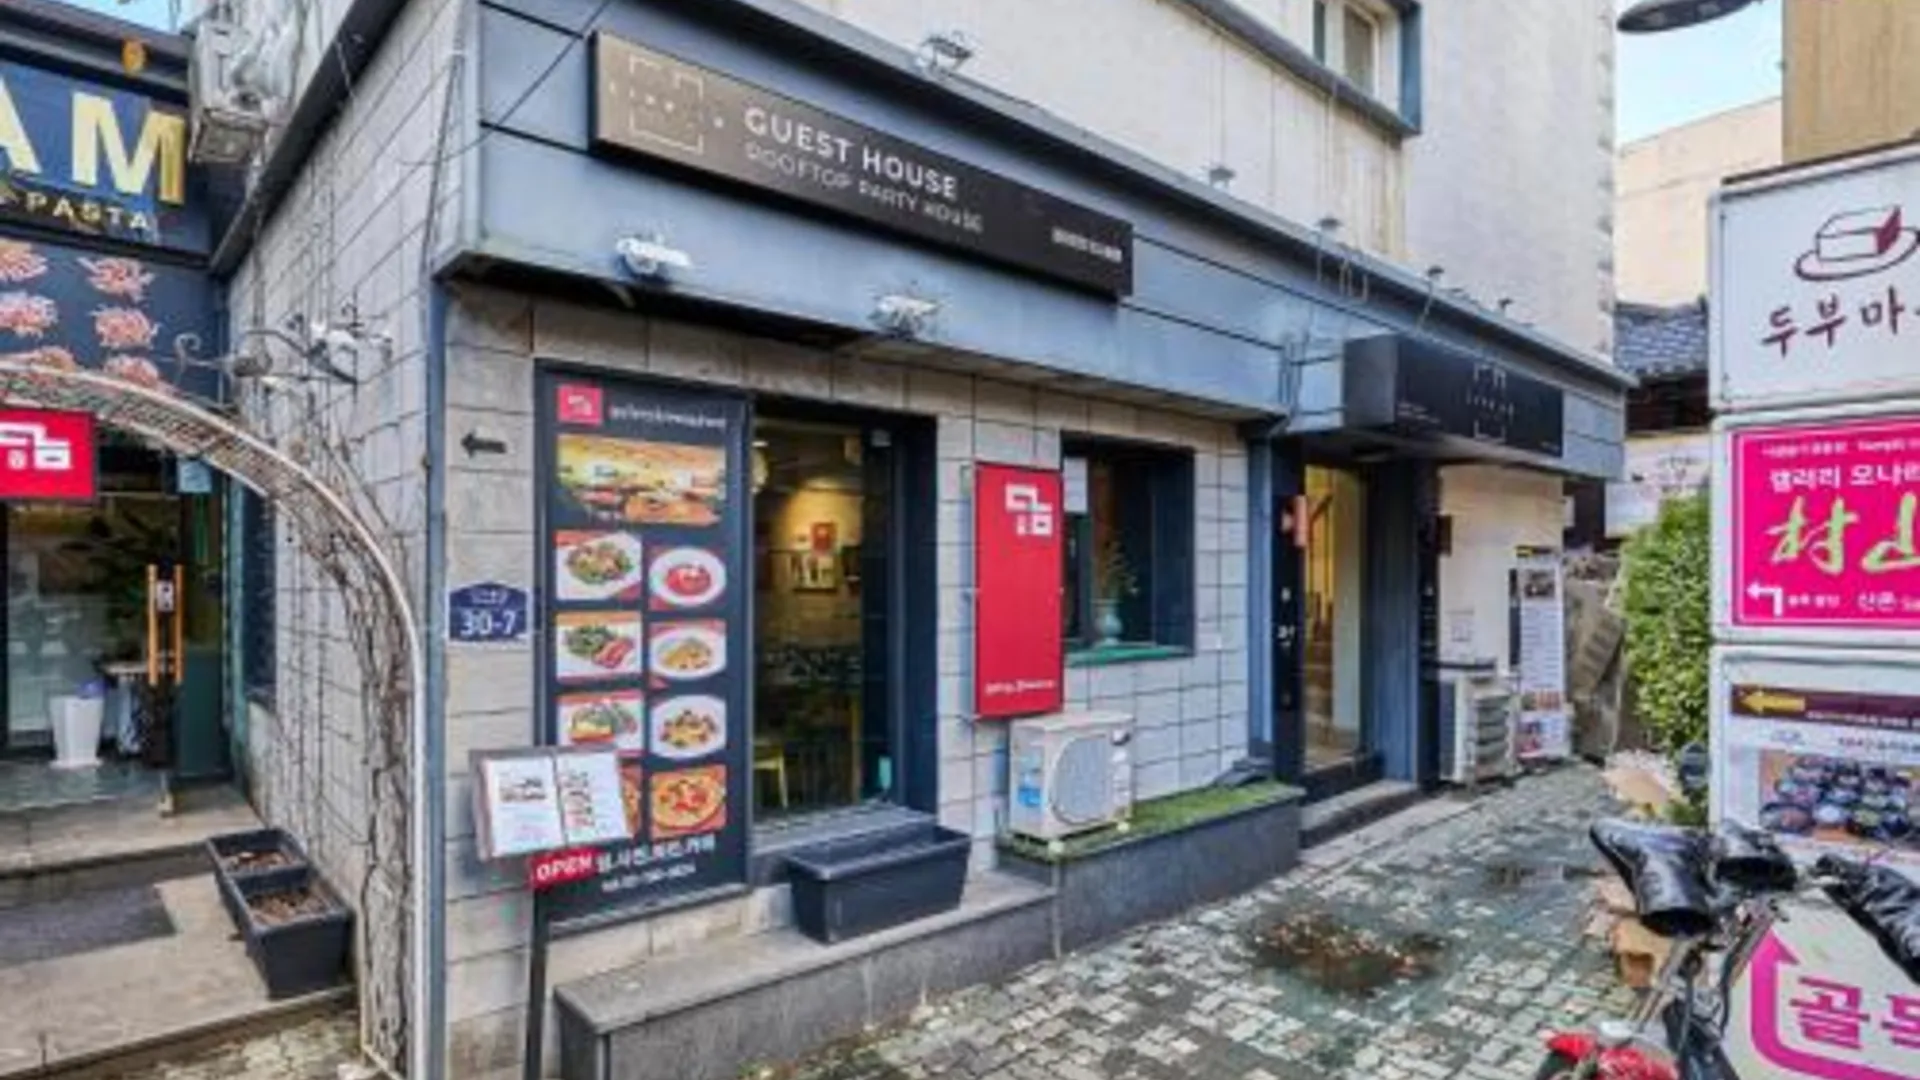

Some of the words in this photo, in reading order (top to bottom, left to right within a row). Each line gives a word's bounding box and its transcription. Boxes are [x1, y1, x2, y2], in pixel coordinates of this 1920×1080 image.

[744, 106, 852, 163] GUEST
[862, 146, 958, 200] HOUSE
[746, 141, 852, 188] ROOFTOP
[858, 179, 919, 212] PARTY
[26, 191, 149, 229] PASTA
[1761, 285, 1920, 358] 두부마
[460, 608, 517, 637] 30-7
[536, 852, 593, 881] OPEN
